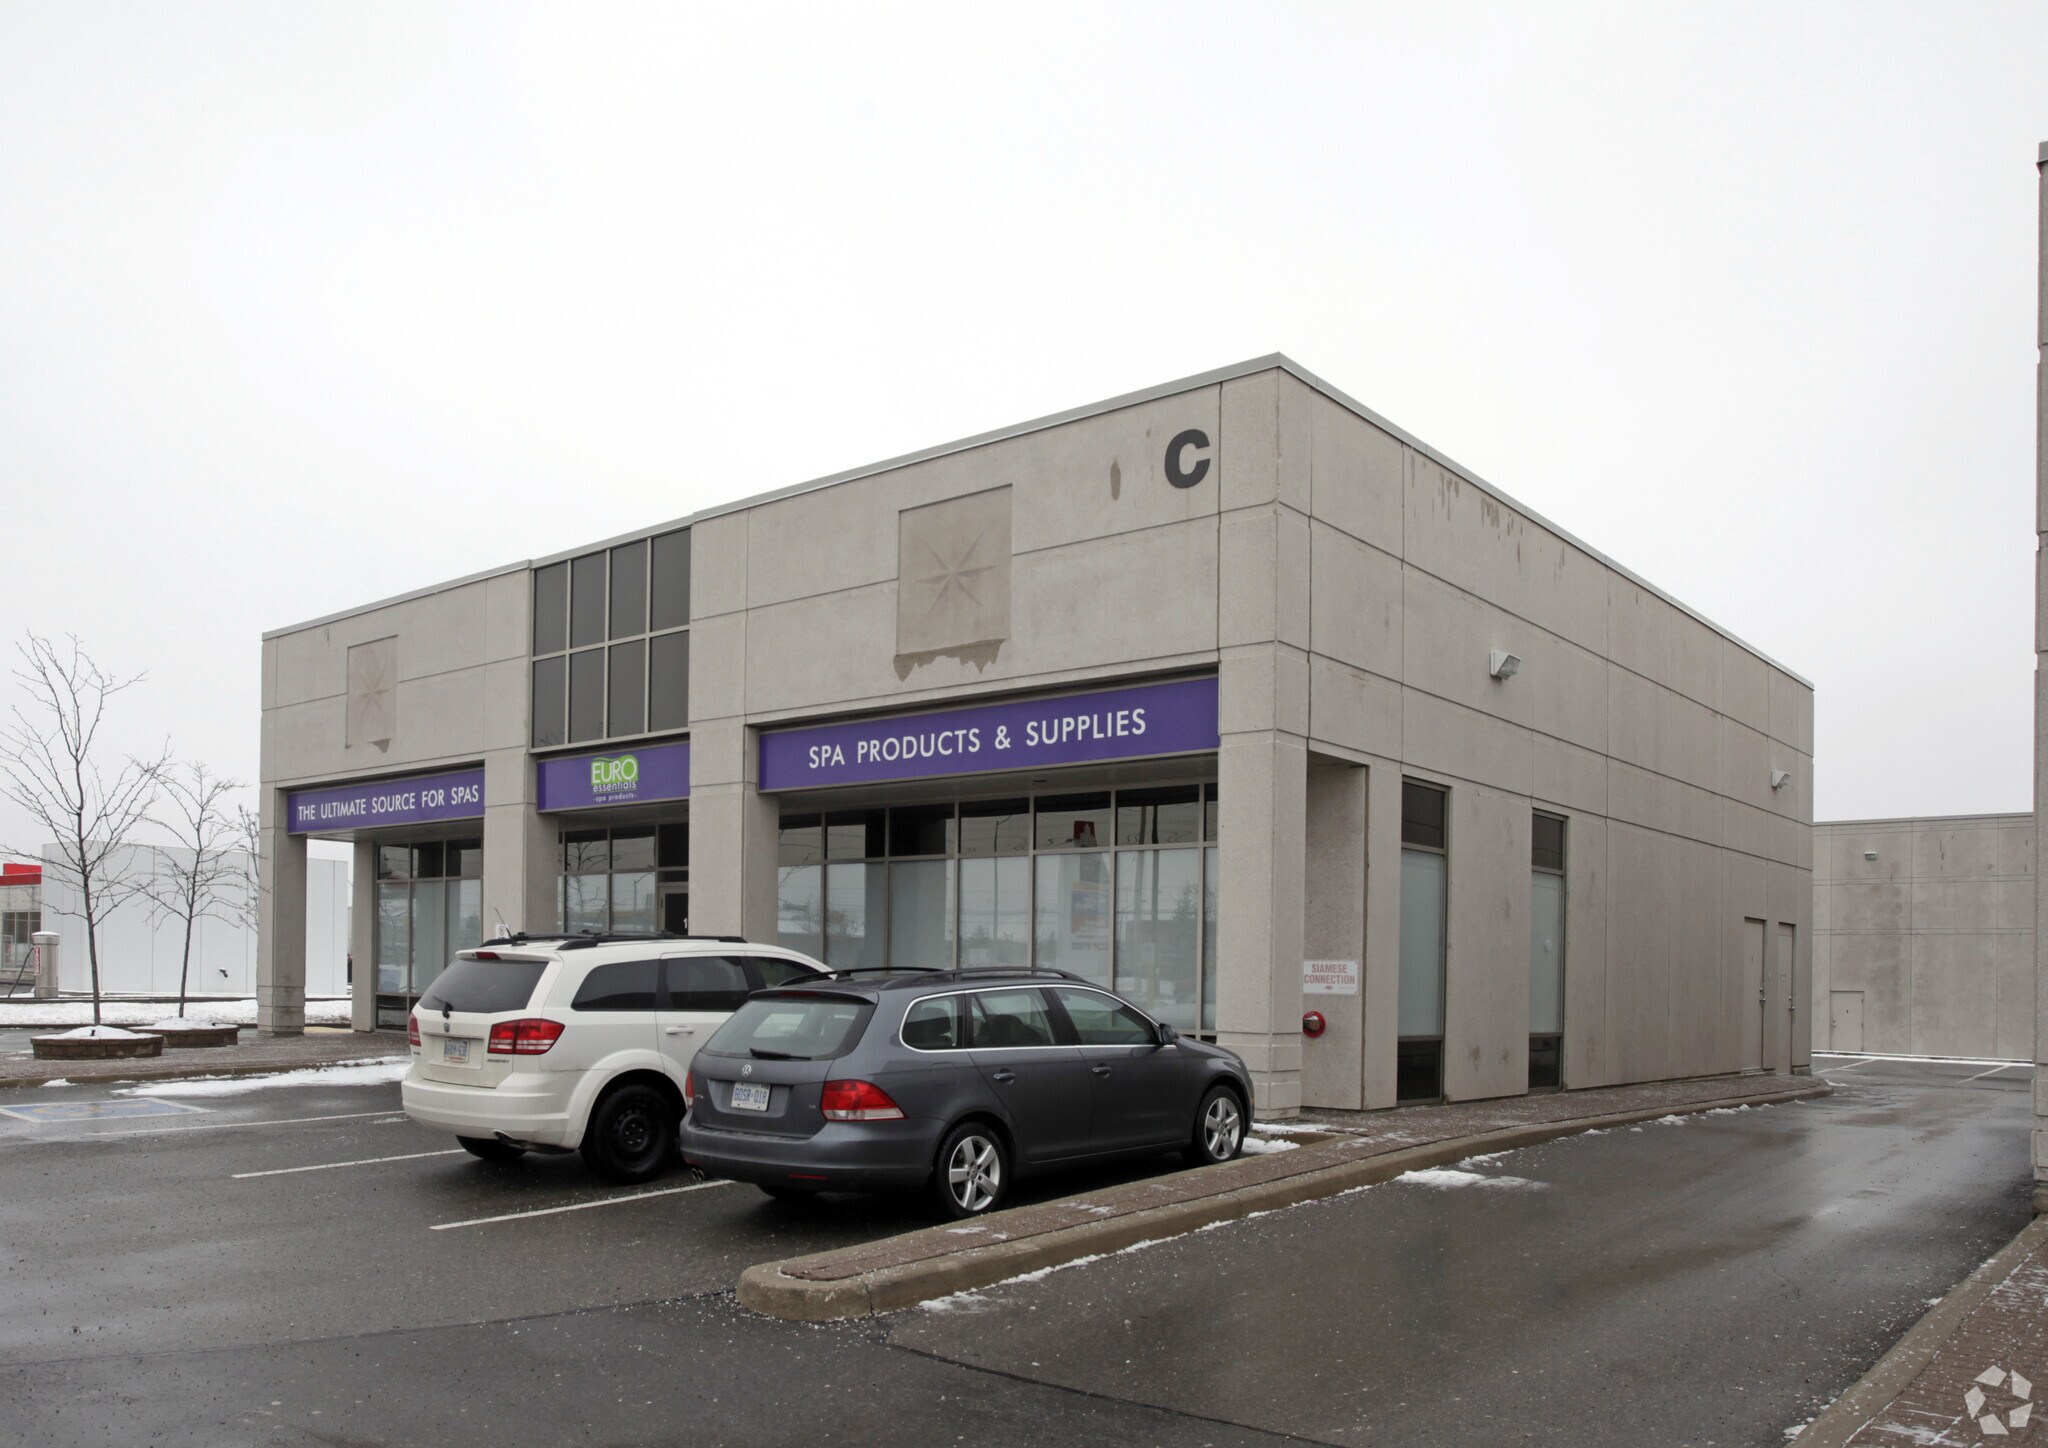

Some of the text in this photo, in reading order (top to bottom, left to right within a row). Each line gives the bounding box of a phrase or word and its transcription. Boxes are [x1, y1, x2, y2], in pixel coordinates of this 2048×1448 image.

[1164, 428, 1211, 489] C
[808, 708, 1147, 769] SPA PRODUCTS & SUPPLIES
[591, 758, 637, 783] EURO
[592, 780, 637, 793] essentials
[298, 784, 479, 821] THE ULTIMATE SOURCE FOR SPAS
[1304, 974, 1356, 985] CONNECTION
[1311, 963, 1348, 974] SIAMESE
